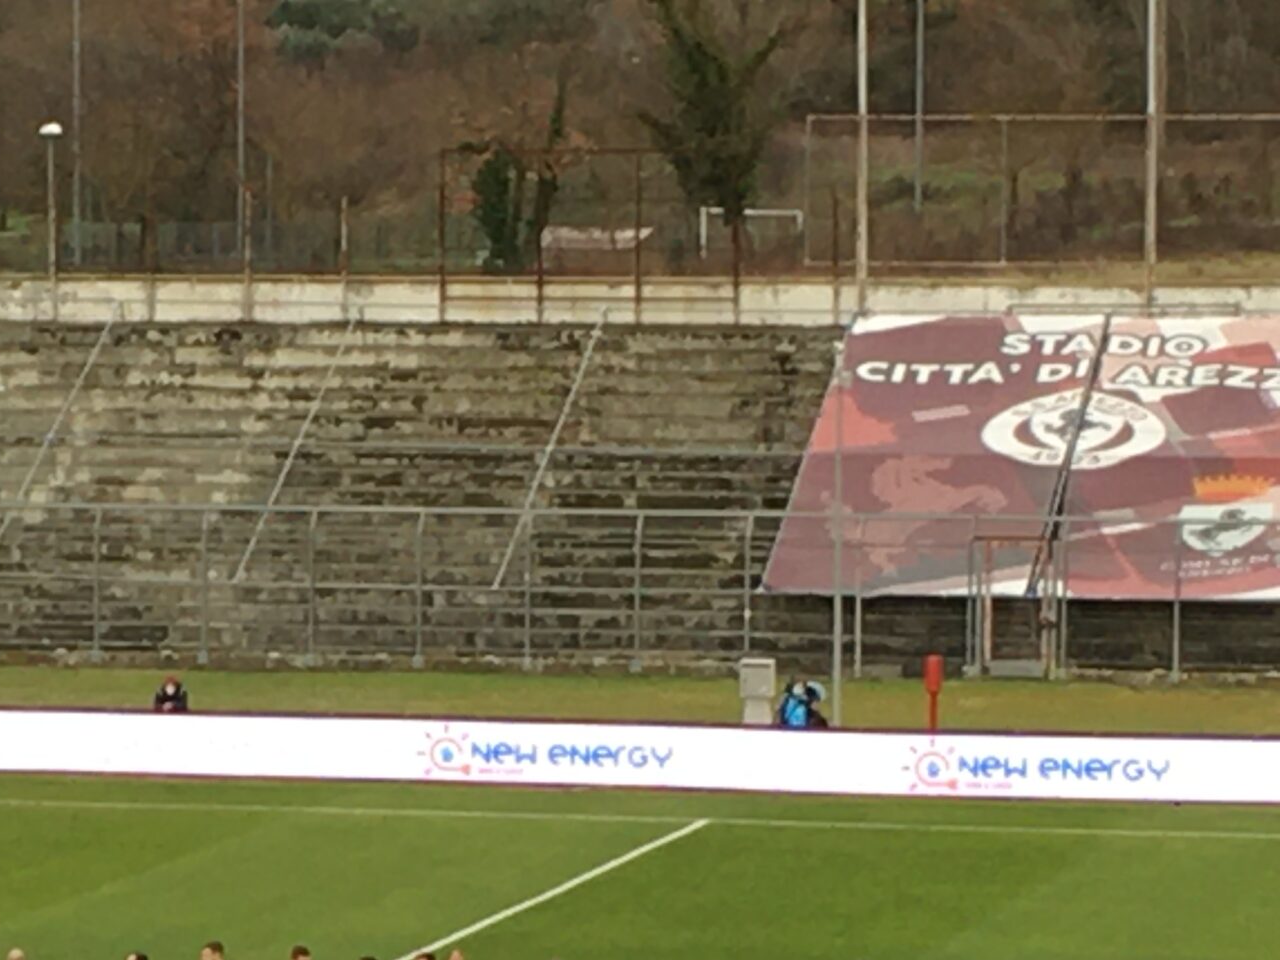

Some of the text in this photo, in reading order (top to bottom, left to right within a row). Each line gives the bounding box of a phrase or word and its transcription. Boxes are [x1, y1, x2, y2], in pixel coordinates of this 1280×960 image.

[999, 333, 1207, 358] STADIO
[855, 361, 1021, 385] CITTA'
[1035, 359, 1091, 383] DI
